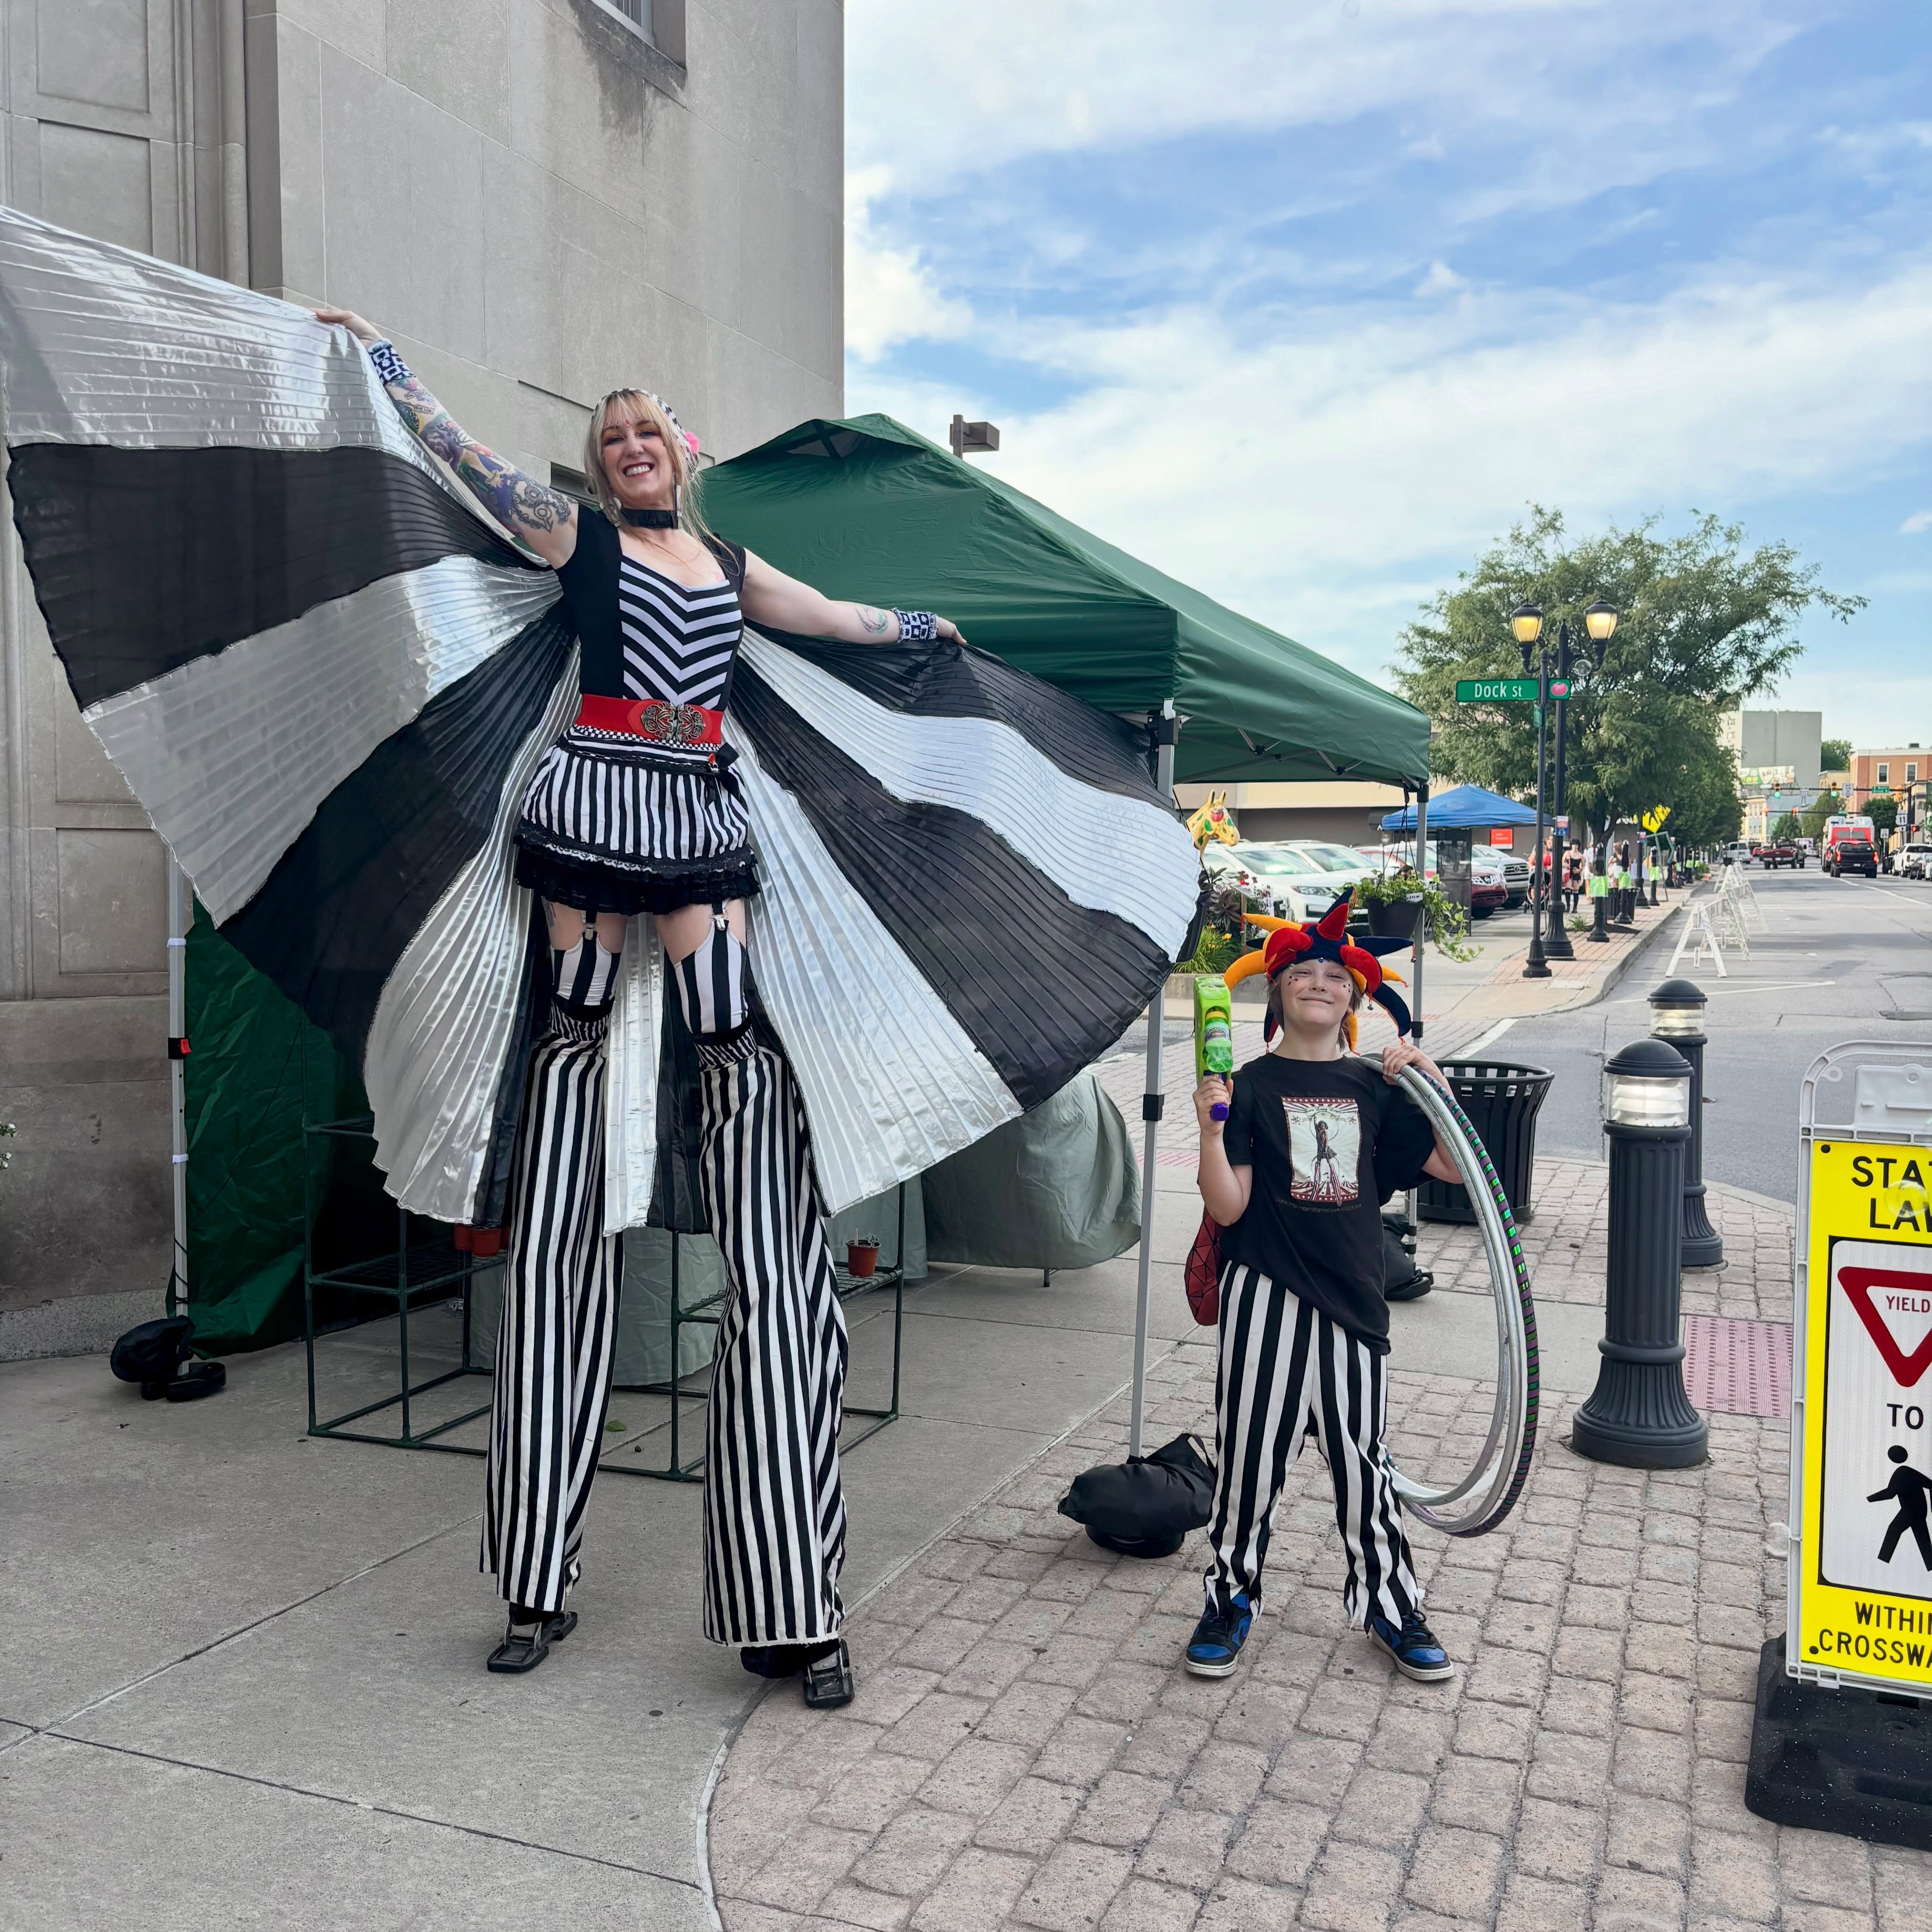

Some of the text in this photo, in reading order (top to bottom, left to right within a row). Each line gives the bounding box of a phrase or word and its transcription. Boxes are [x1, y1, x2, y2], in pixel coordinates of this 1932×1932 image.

[1474, 682, 1507, 698] Dock
[1851, 1156, 1932, 1190] STA
[1886, 1295, 1931, 1313] YIELD
[1887, 1403, 1924, 1430] TO
